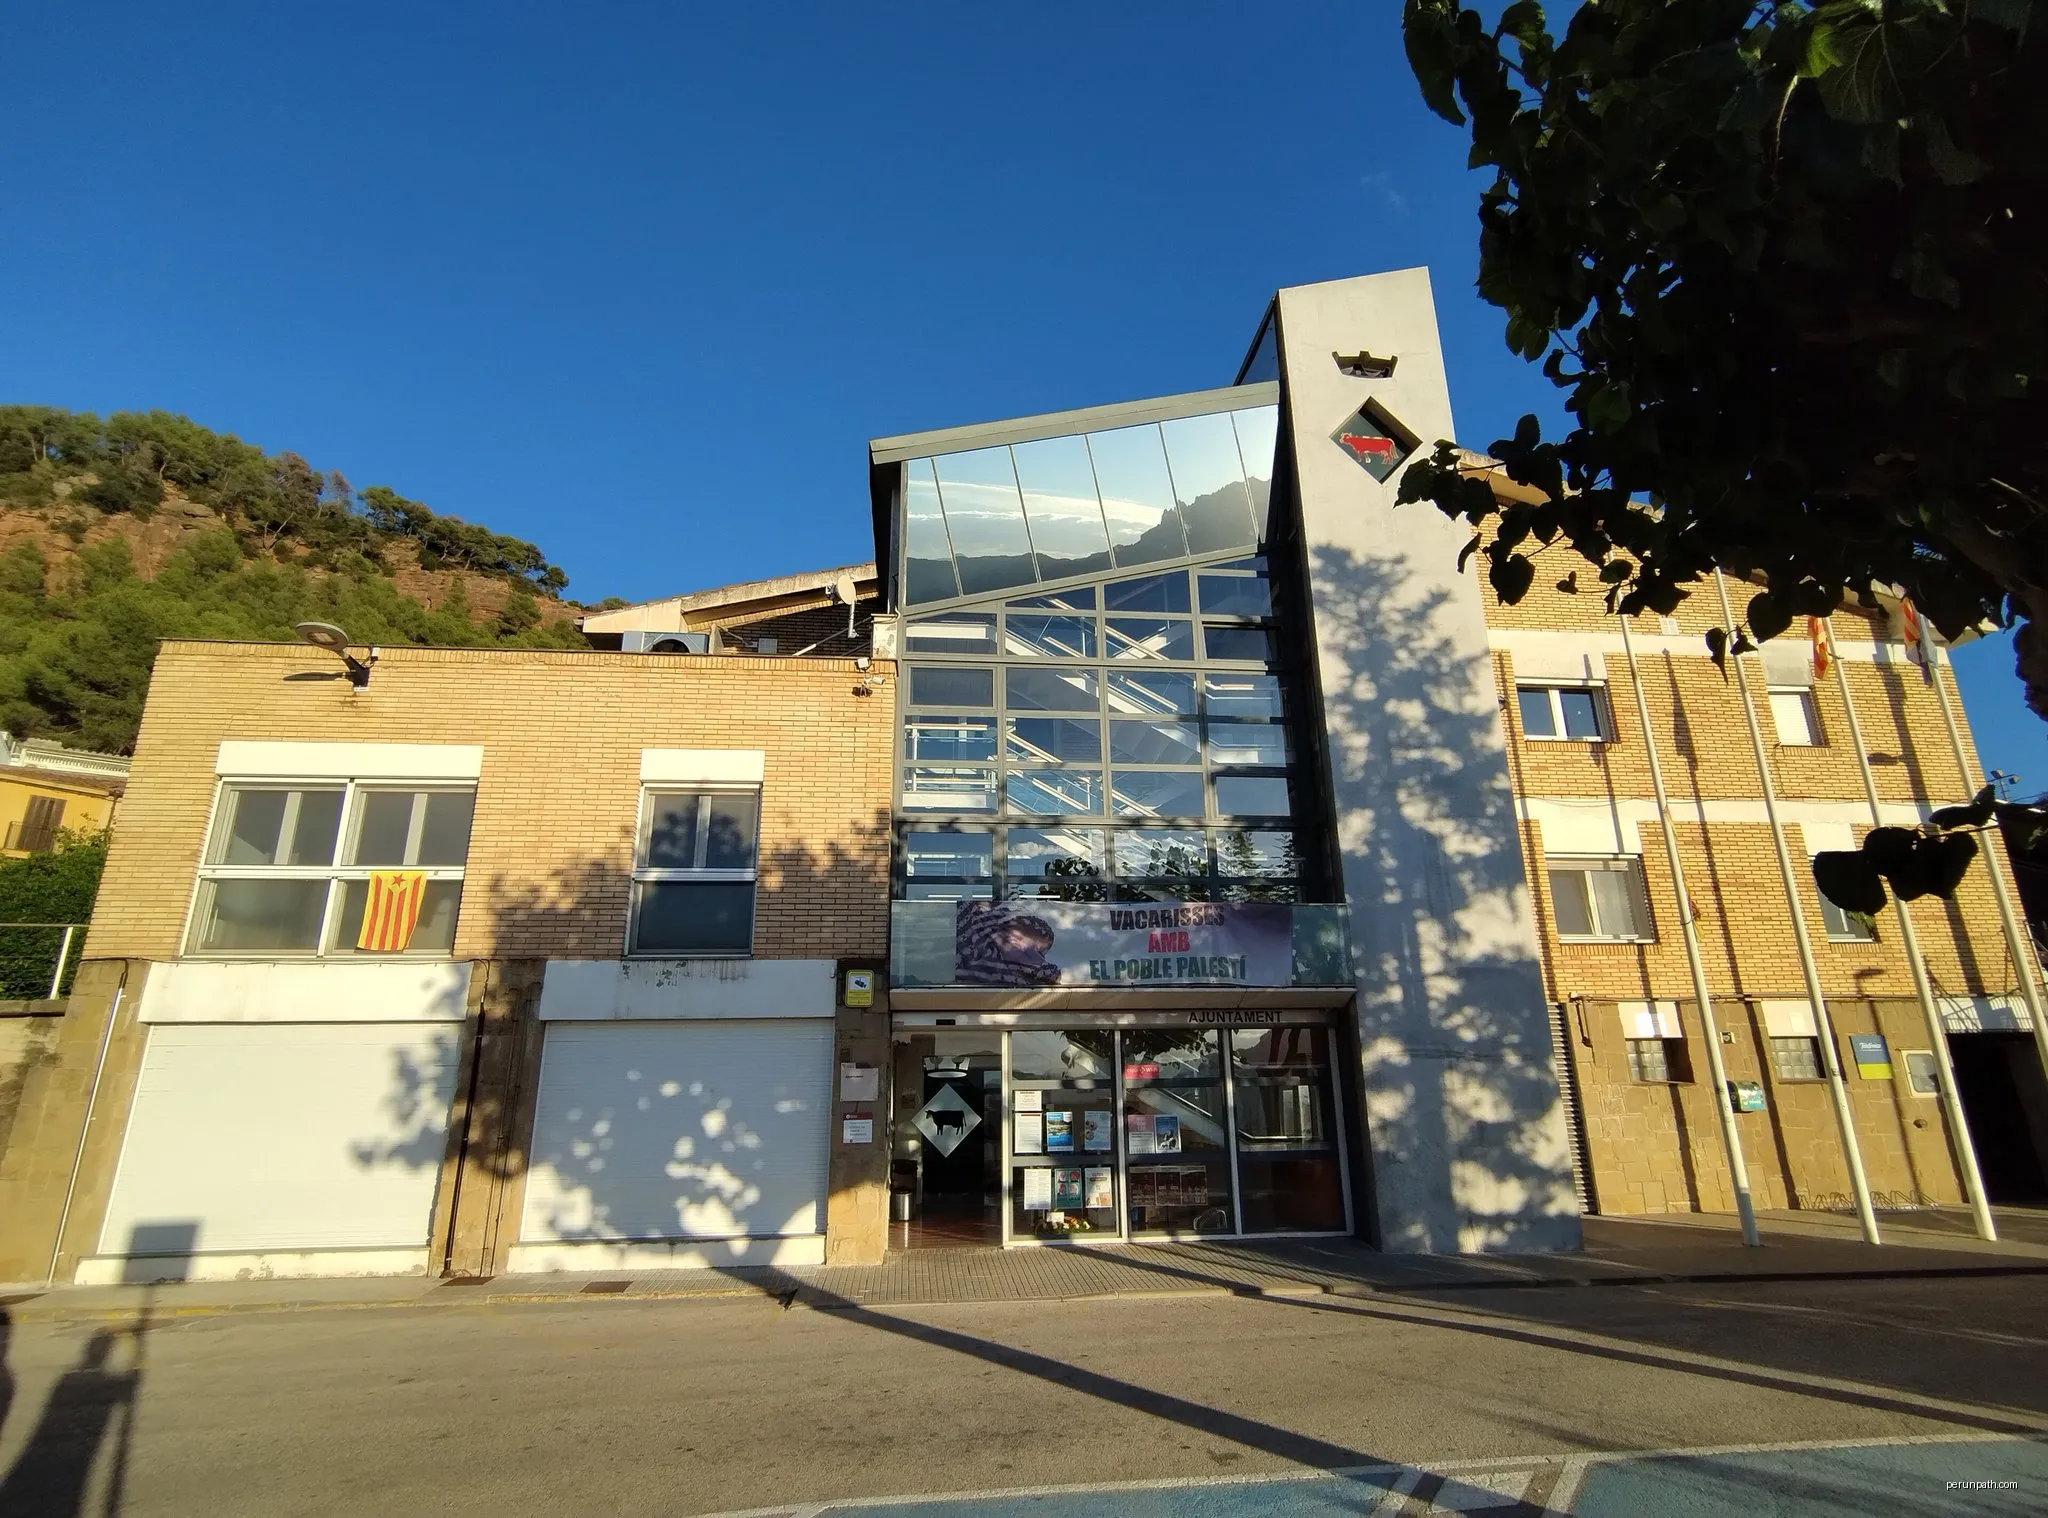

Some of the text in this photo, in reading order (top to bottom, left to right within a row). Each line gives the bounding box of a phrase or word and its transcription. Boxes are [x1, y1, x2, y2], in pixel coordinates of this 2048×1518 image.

[1110, 906, 1225, 930] VACARISSES
[1148, 931, 1190, 953] AMB
[1089, 955, 1247, 980] EL POBLE PALESTÍ
[1188, 1011, 1283, 1023] AJUNTAMENT
